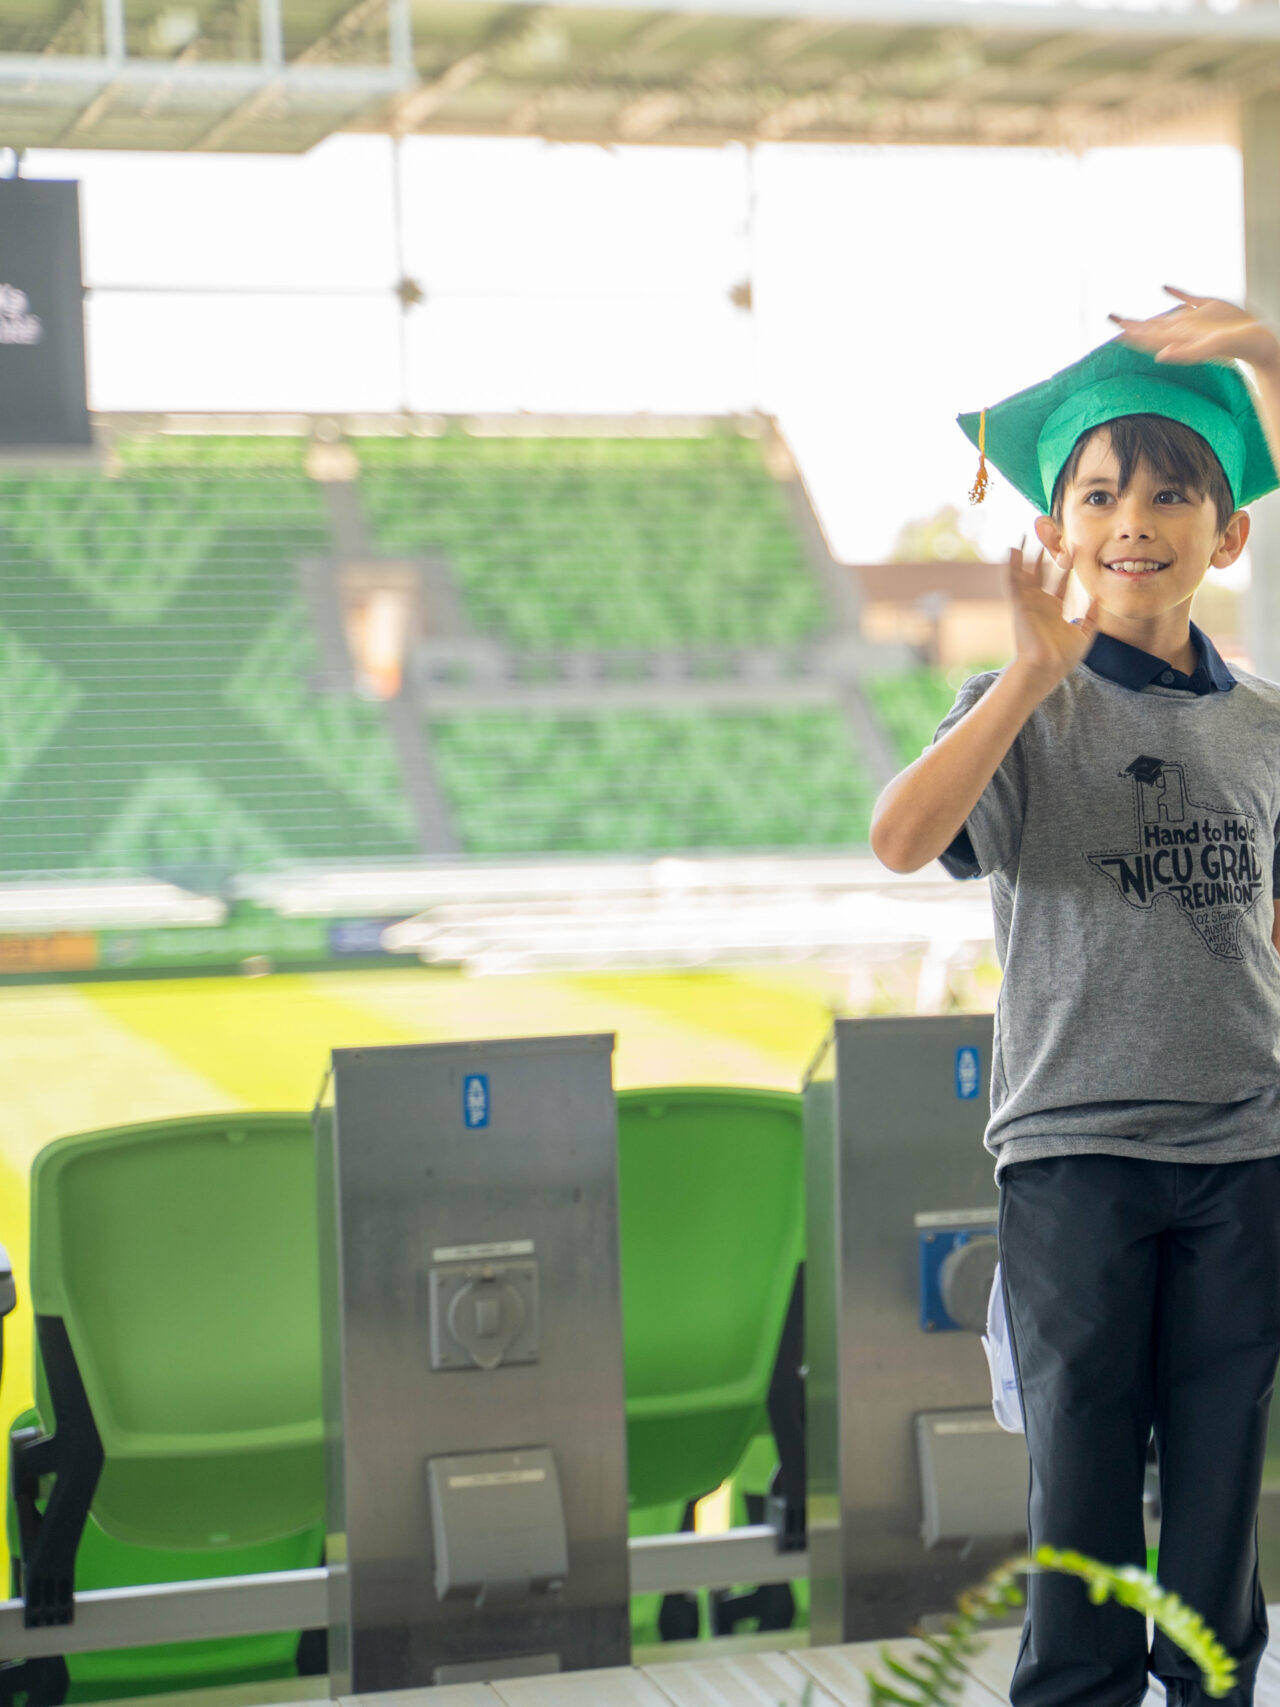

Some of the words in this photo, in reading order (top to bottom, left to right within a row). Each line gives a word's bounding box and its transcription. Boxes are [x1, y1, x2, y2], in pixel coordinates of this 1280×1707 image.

[1144, 821, 1199, 848] Hand
[1202, 819, 1222, 842] to
[1101, 847, 1193, 903] NICU
[1200, 843, 1262, 885] GRAD
[1168, 882, 1262, 910] REUNION
[1196, 913, 1210, 925] Q2
[1213, 941, 1238, 956] 2024
[468, 1078, 485, 1125] AMP
